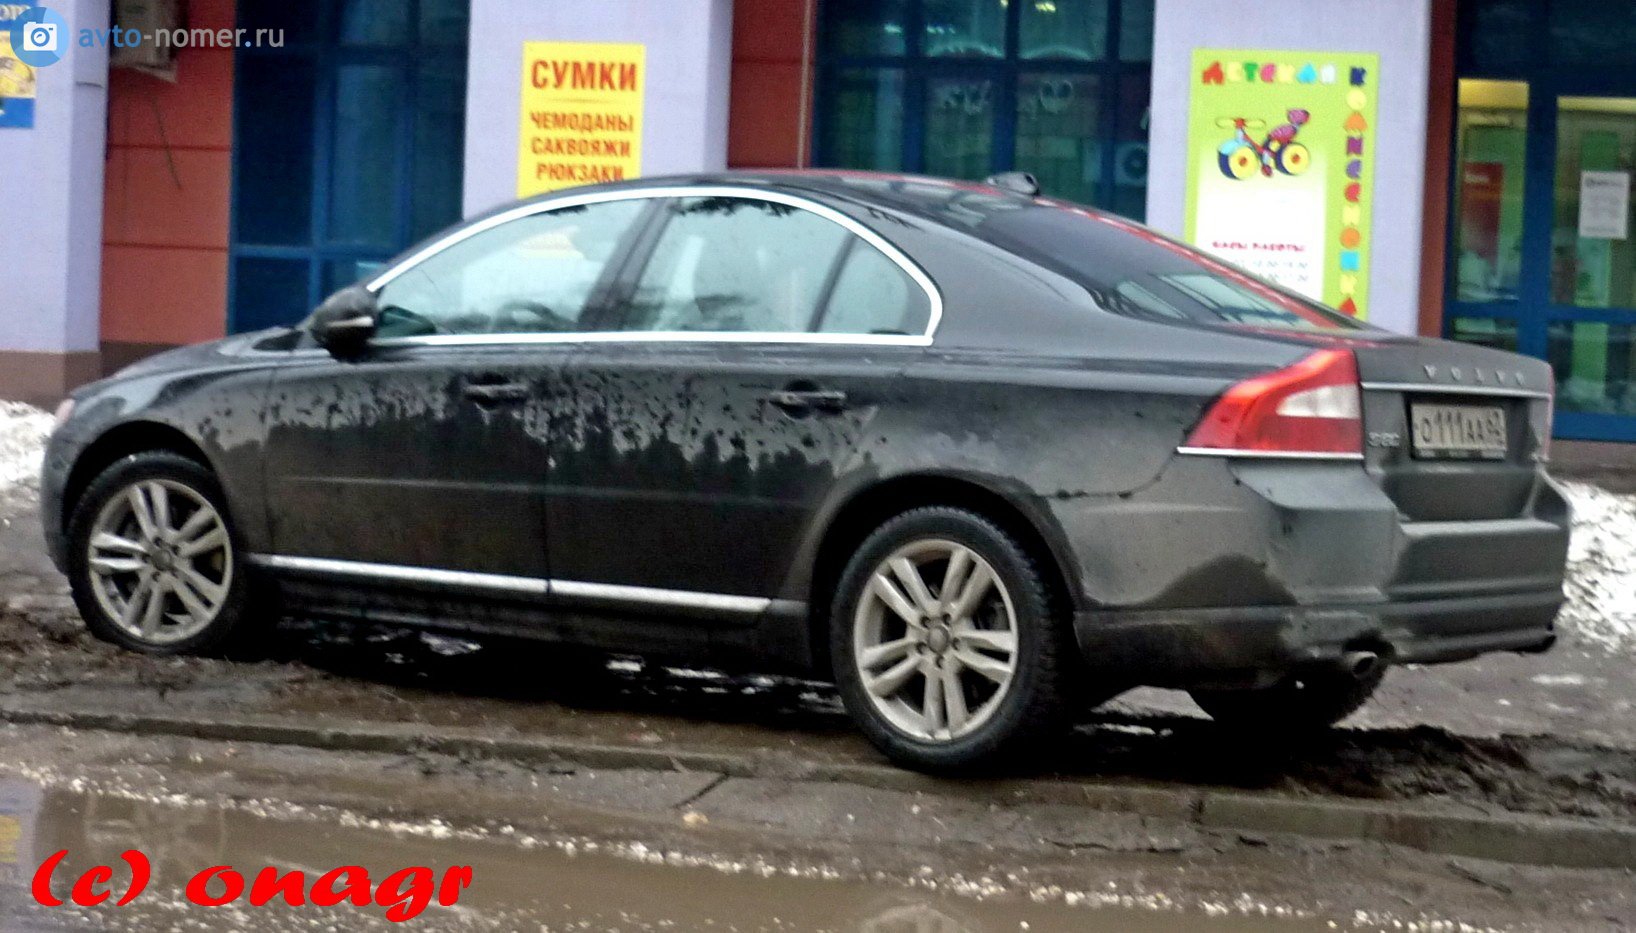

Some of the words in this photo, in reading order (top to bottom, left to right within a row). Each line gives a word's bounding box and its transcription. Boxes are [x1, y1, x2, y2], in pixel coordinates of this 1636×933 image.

[531, 60, 637, 91] СУМКИ
[530, 111, 634, 134] ЧЕМОДАНЫ
[531, 136, 631, 158] САКВОЯЖИ
[536, 162, 624, 182] РЮКЗАКИ
[1423, 364, 1526, 386] VOLVO
